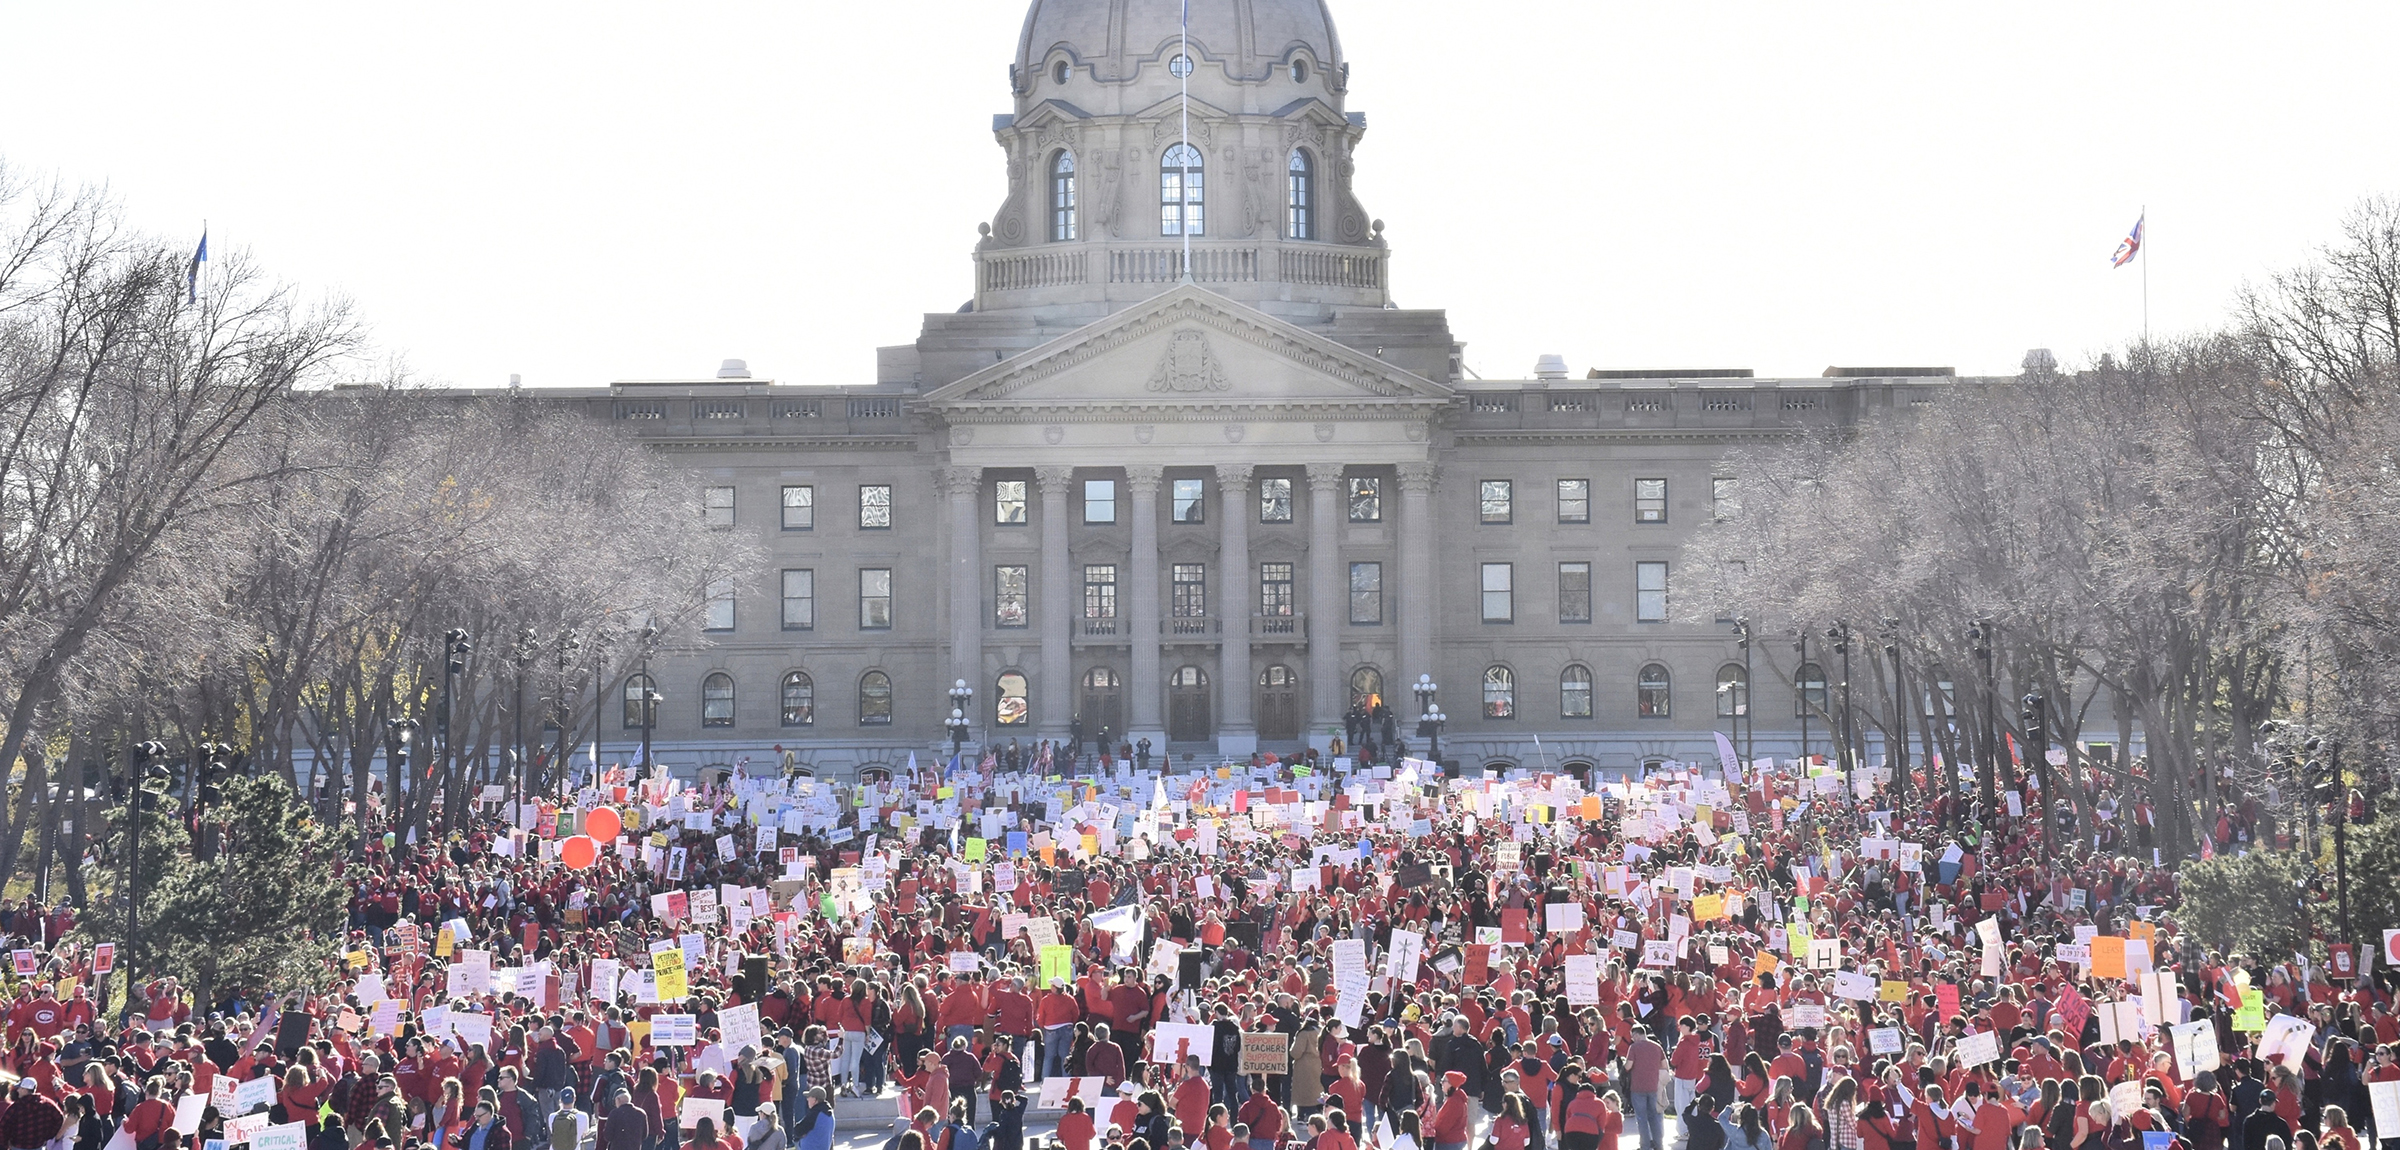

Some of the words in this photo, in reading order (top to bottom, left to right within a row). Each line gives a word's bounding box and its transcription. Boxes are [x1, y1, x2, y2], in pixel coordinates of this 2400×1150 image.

[700, 904, 715, 913] BEST
[1244, 1035, 1287, 1045] SUPPORTED
[1244, 1044, 1287, 1053] TEACHERS
[1873, 1042, 1900, 1050] EDUCATION
[1245, 1052, 1284, 1062] SUPPORT
[1243, 1061, 1287, 1072] STUDENTS
[258, 1134, 298, 1148] CRITICAL
